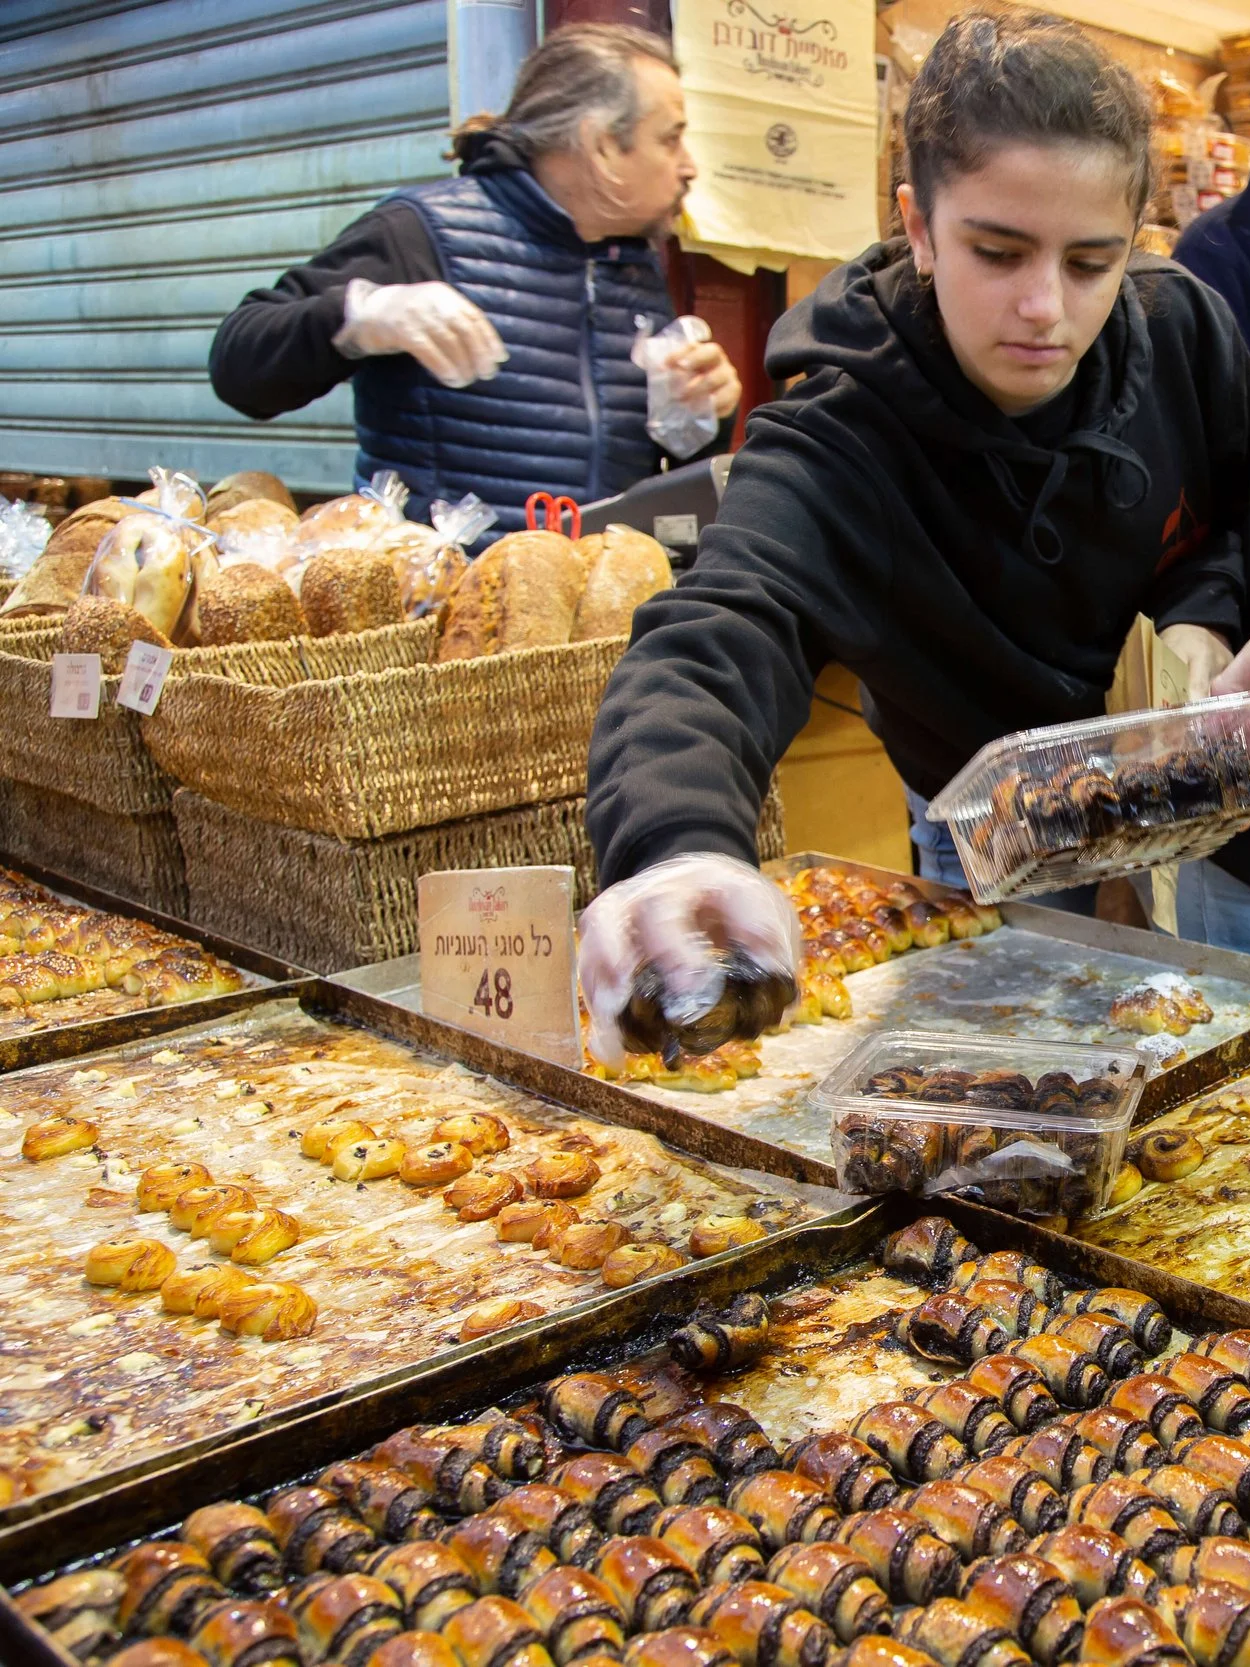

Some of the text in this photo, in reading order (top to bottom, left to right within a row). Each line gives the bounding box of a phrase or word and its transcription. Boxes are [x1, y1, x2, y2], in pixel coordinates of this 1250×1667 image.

[434, 924, 552, 957] כל סוגי העוגיות
[474, 968, 514, 1019] 48
